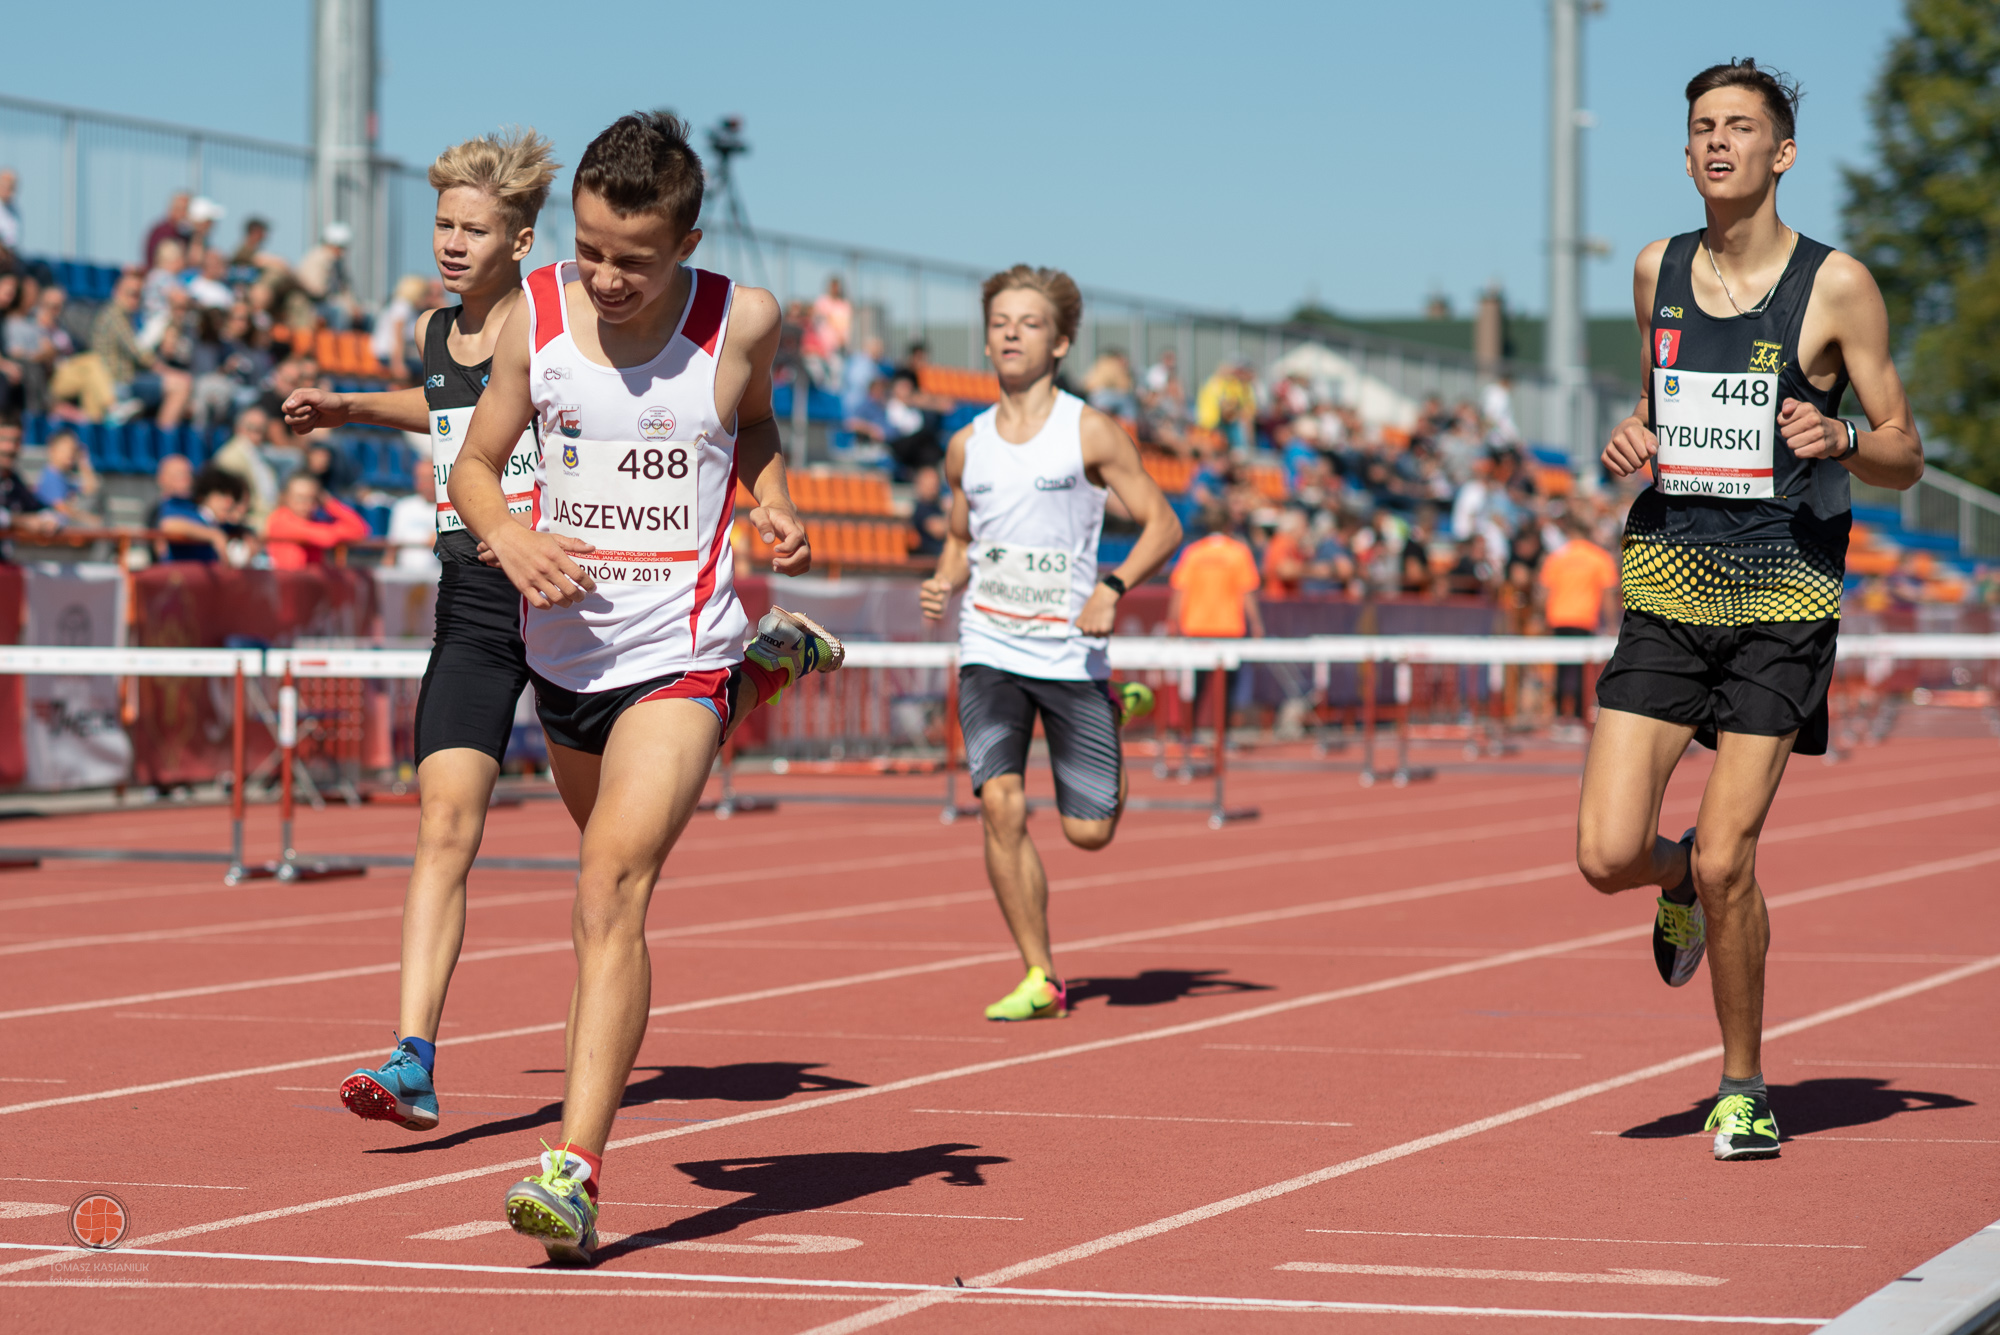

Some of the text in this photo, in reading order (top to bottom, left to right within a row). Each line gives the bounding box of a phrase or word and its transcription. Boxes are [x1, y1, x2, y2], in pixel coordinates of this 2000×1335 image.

[1660, 306, 1684, 319] esa
[544, 366, 573, 381] esa
[1711, 378, 1769, 407] 448
[1656, 424, 1761, 451] TYBURSKI
[617, 448, 688, 480] 488
[1661, 477, 1751, 495] TARNÓW 2019
[553, 497, 689, 531] JASZEWSKI
[1025, 553, 1067, 573] 163
[632, 568, 672, 582] 2019
[979, 579, 1066, 605] ANDRUSIEWICZ
